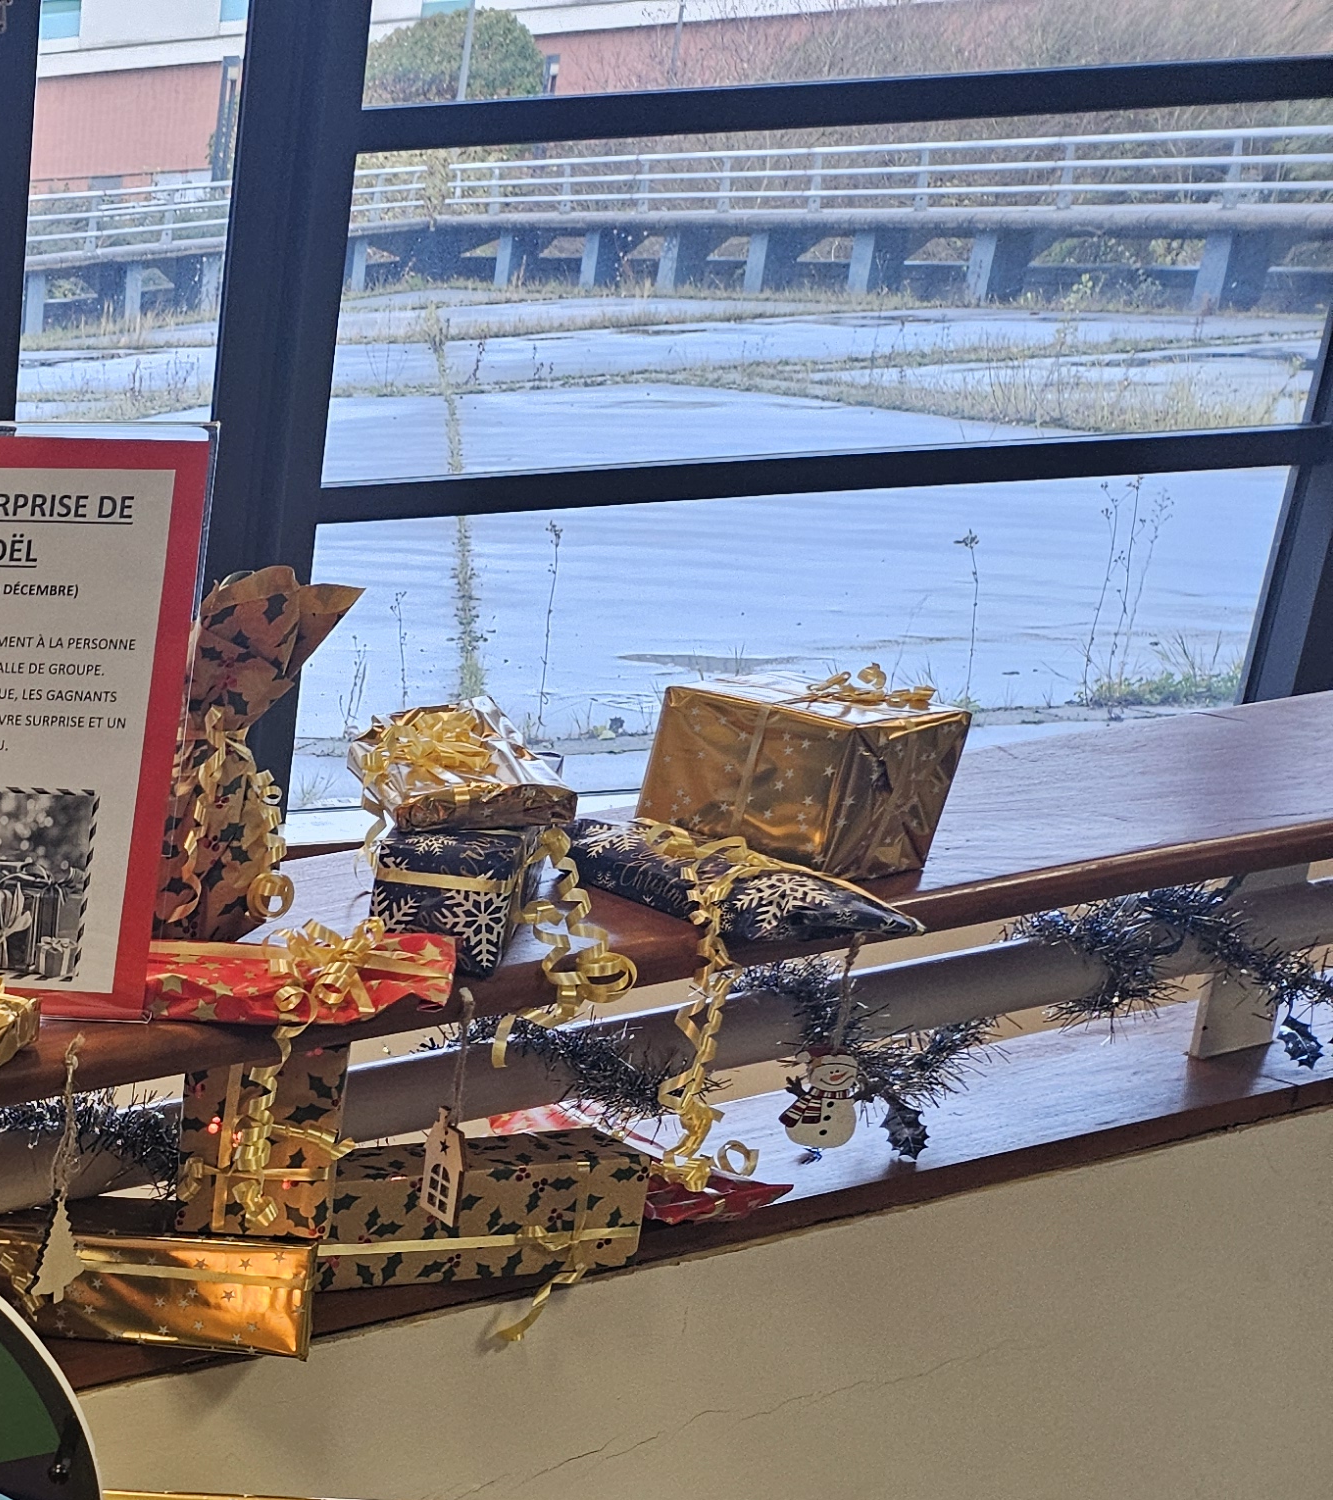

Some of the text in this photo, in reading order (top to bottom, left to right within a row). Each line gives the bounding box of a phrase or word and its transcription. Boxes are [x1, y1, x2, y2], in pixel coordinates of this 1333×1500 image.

[97, 495, 135, 520] DE
[2, 580, 79, 600] DÉCEMBRE)
[35, 633, 46, 649] À
[48, 636, 64, 649] LA
[66, 637, 137, 651] PERSONNE
[28, 662, 46, 675] DE
[48, 663, 105, 677] GROUPE.
[21, 688, 43, 701] LES
[45, 689, 118, 703] GAGNANTS
[24, 714, 86, 729] SURPRISE
[88, 716, 105, 729] ET
[107, 717, 127, 730] UN
